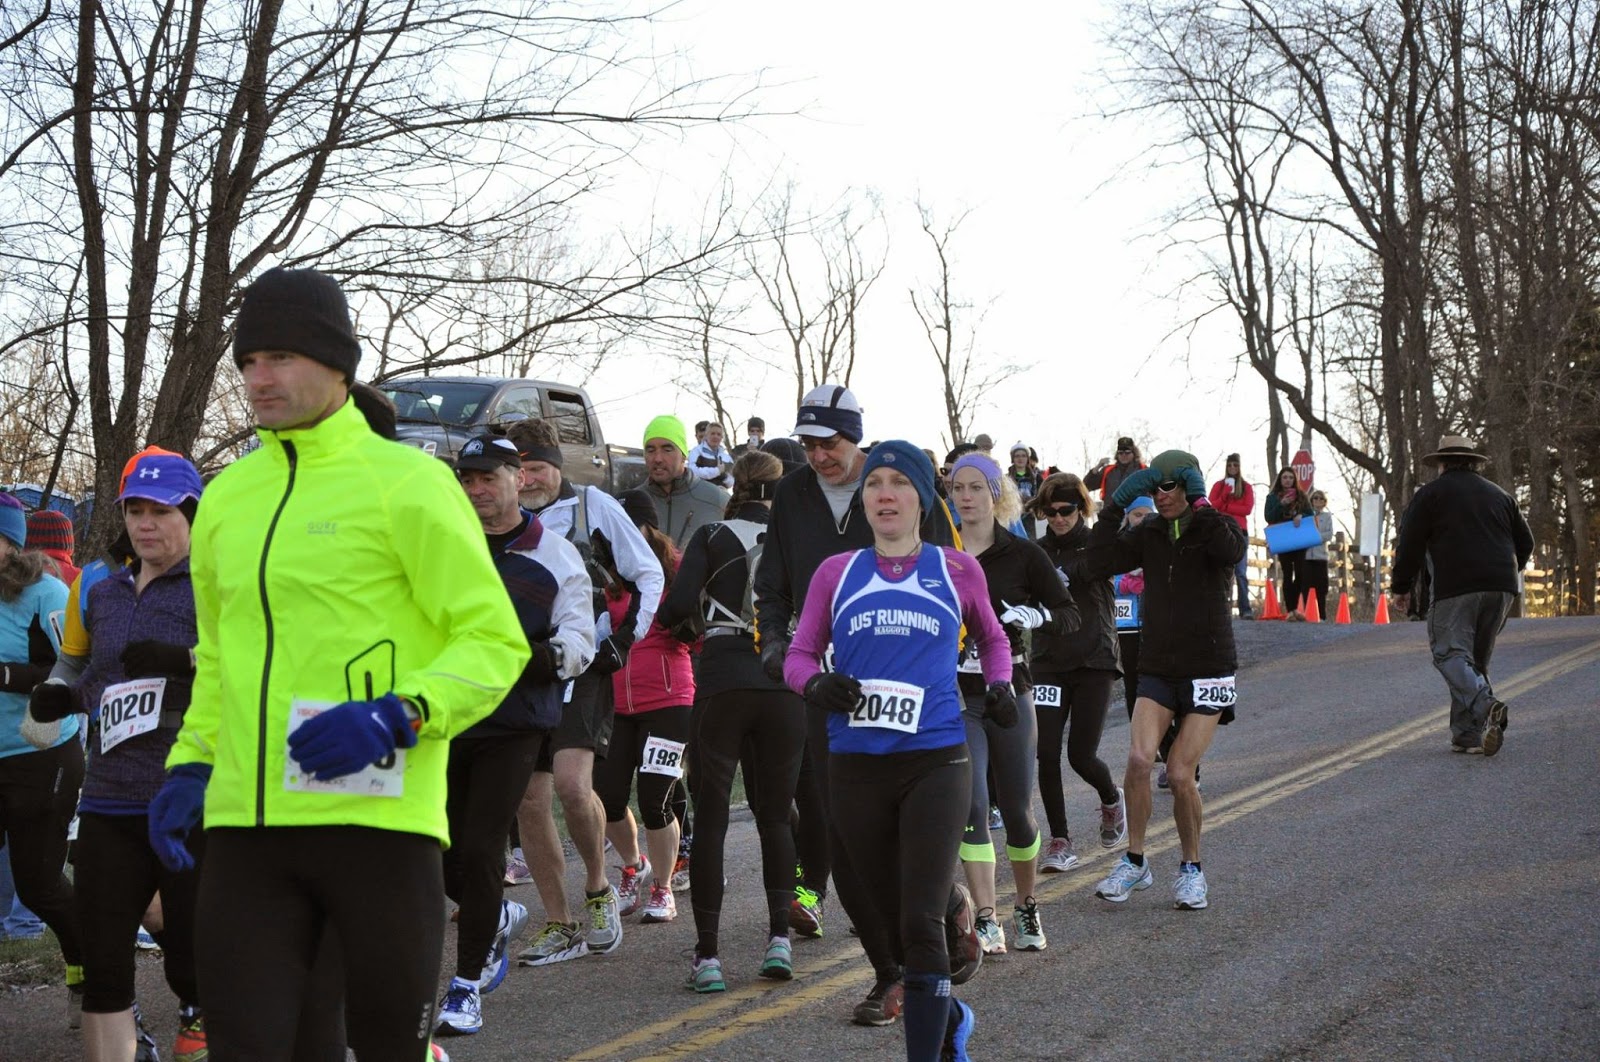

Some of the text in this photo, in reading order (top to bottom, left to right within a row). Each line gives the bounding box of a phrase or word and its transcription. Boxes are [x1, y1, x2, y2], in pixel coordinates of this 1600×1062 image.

[848, 609, 940, 636] JUS' RUNNING
[102, 691, 156, 734] 2020
[853, 694, 916, 726] 2048
